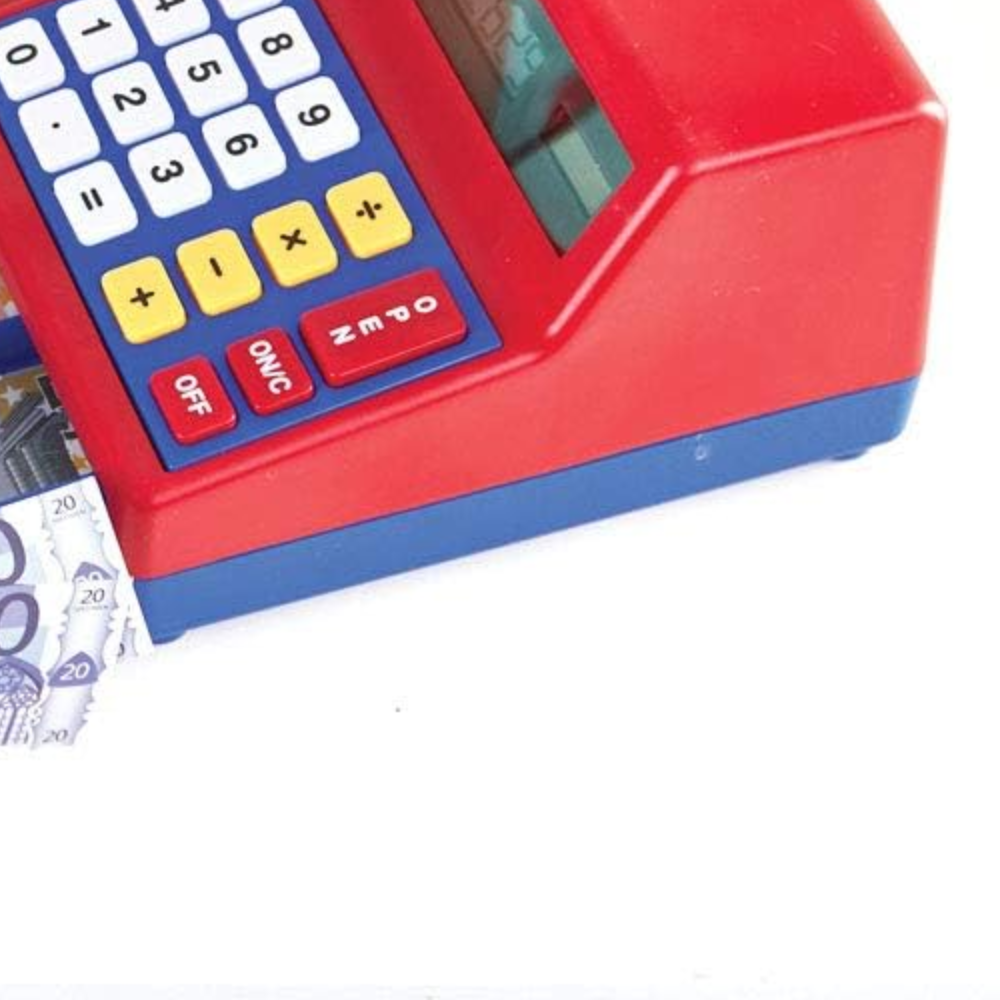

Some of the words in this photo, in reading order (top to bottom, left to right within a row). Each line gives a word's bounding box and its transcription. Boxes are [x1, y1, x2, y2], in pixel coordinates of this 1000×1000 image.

[81, 17, 112, 37] 1
[5, 43, 38, 65] 0
[260, 32, 294, 55] 8
[187, 59, 222, 82] 5
[112, 87, 147, 112] 2
[297, 103, 332, 127] 9
[225, 132, 259, 156] 6
[150, 159, 185, 183] 3
[328, 295, 438, 346] OPEN
[248, 339, 293, 395] ON/C
[174, 374, 214, 415] OFF
[51, 494, 77, 515] 20
[80, 587, 106, 605] 20
[60, 661, 91, 681] 20
